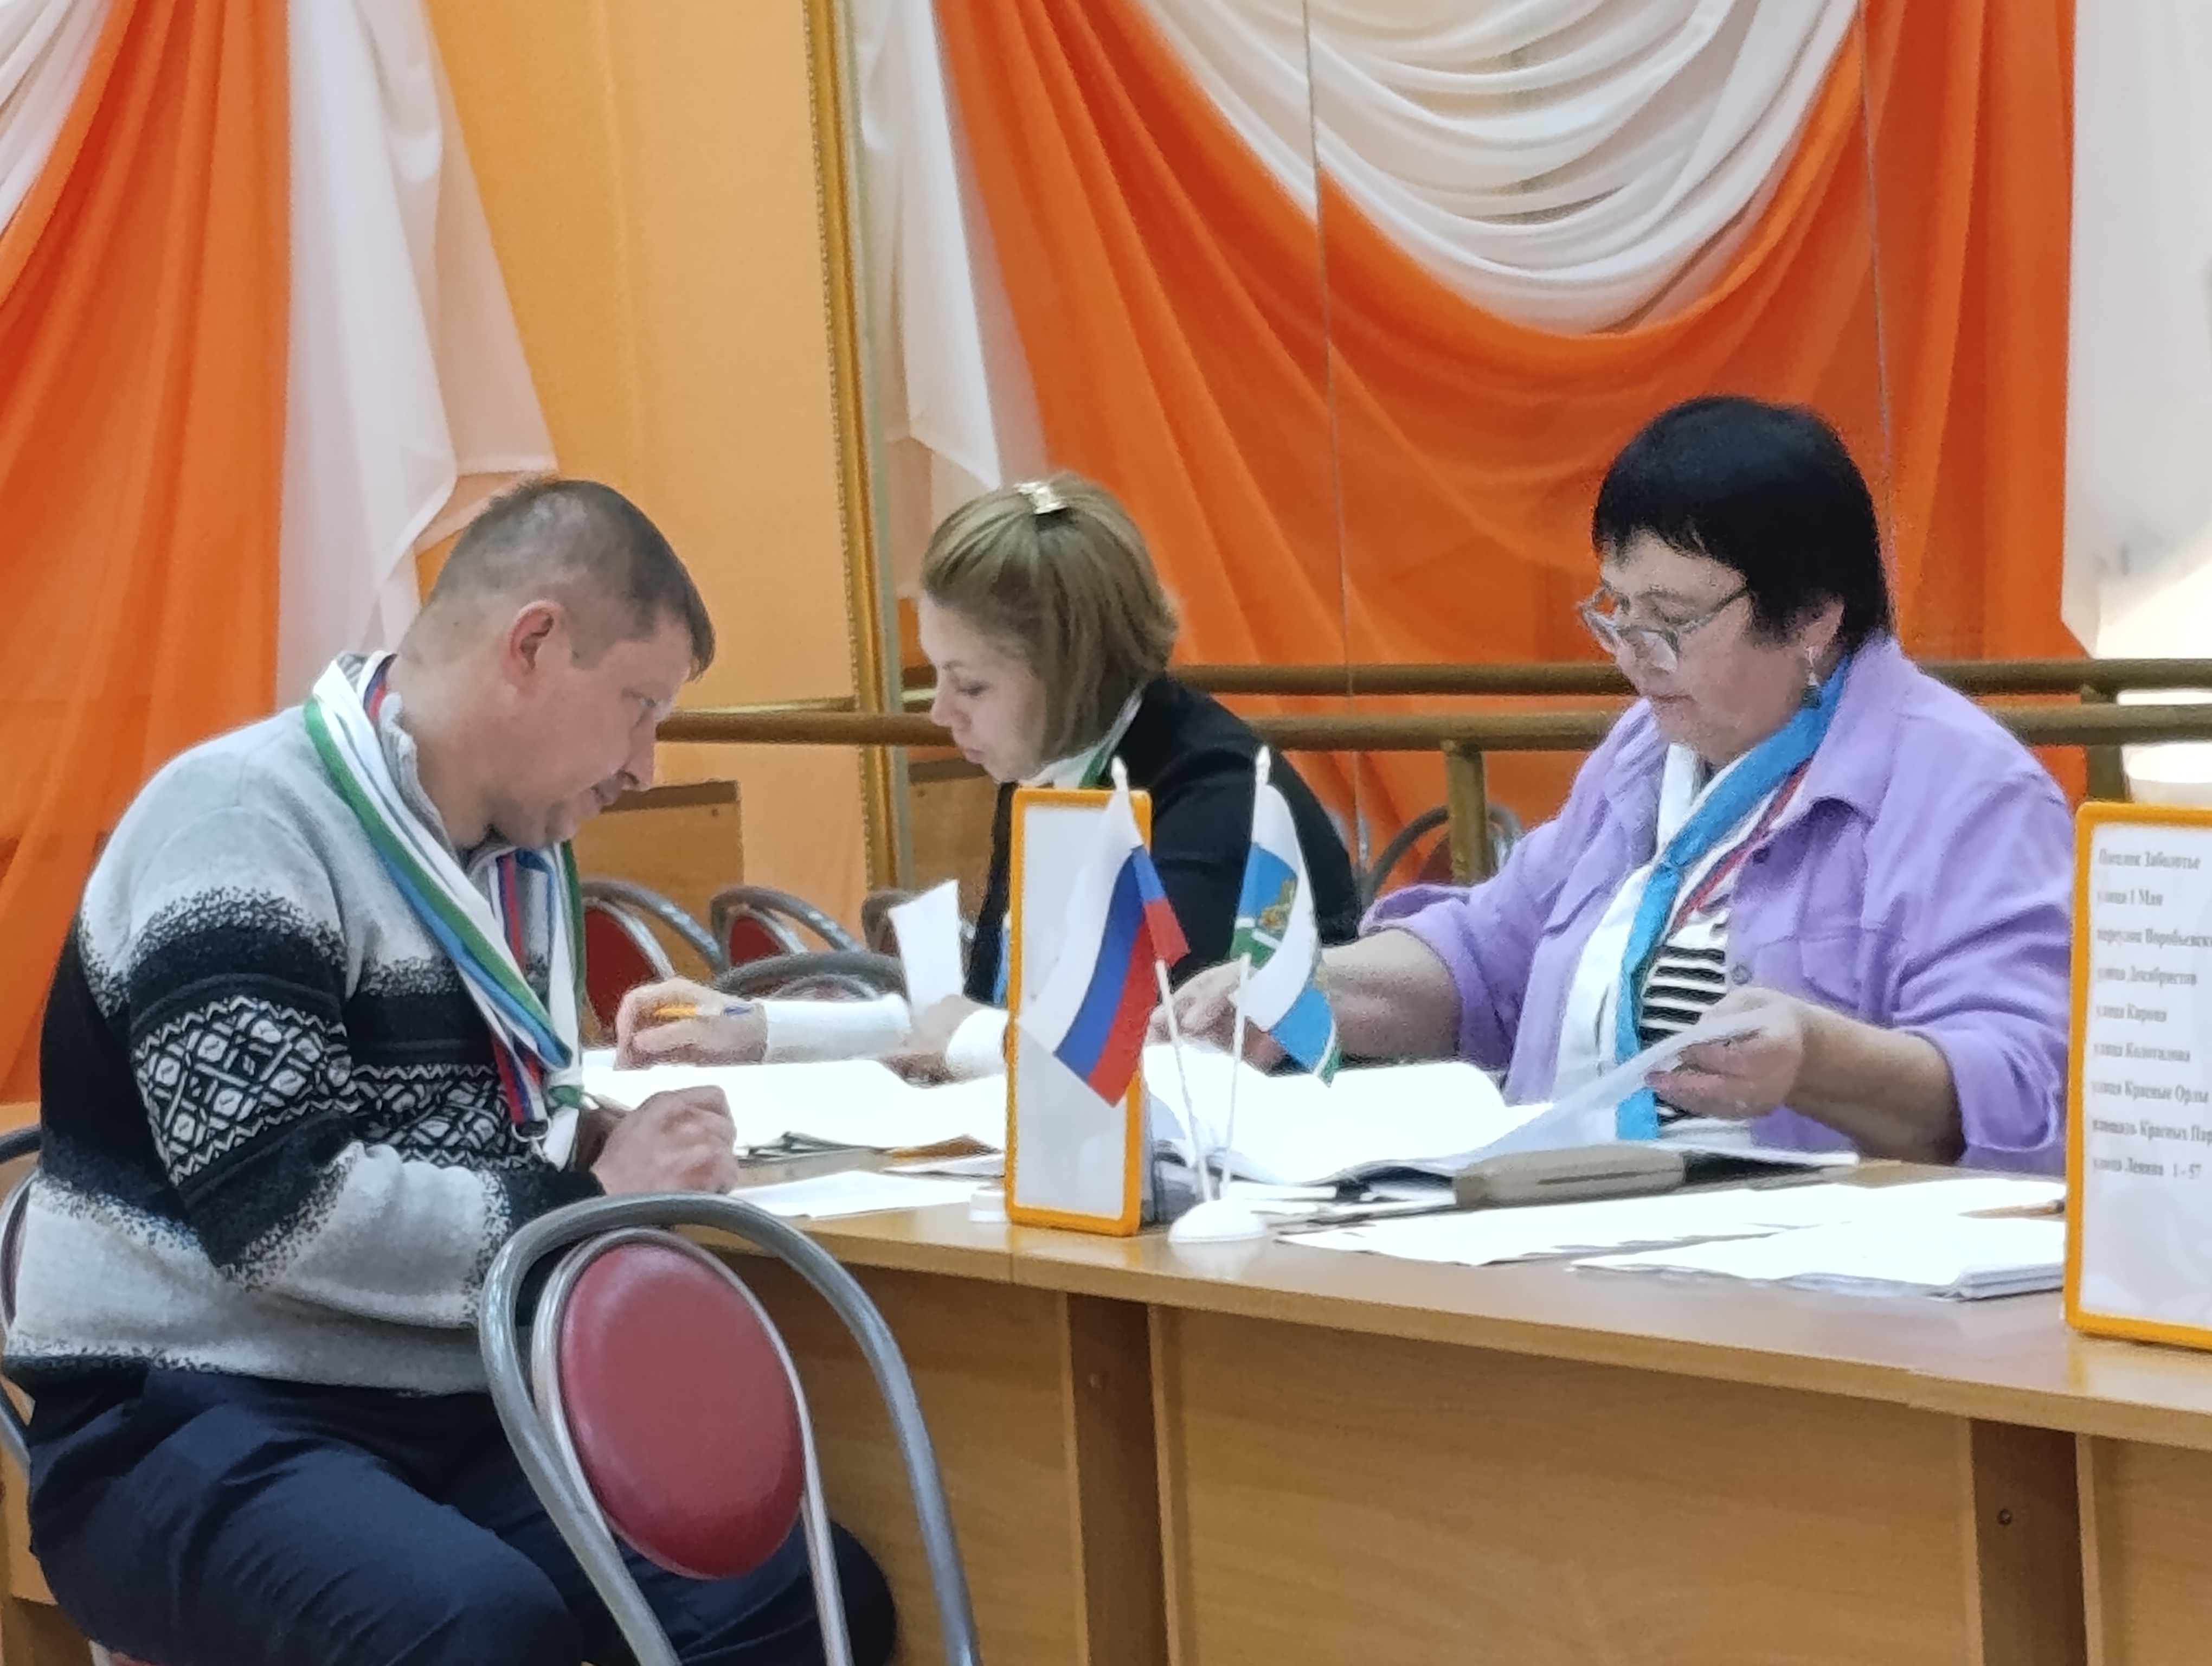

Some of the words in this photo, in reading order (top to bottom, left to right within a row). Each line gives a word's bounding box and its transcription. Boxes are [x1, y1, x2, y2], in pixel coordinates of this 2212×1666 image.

[2139, 889, 2163, 906] Мая
[2126, 1003, 2167, 1024] Кирова
[2125, 1080, 2172, 1100] Красные
[2175, 1084, 2209, 1105] Орлы
[2140, 1119, 2188, 1140] Красных
[2125, 1157, 2164, 1176] Ленина
